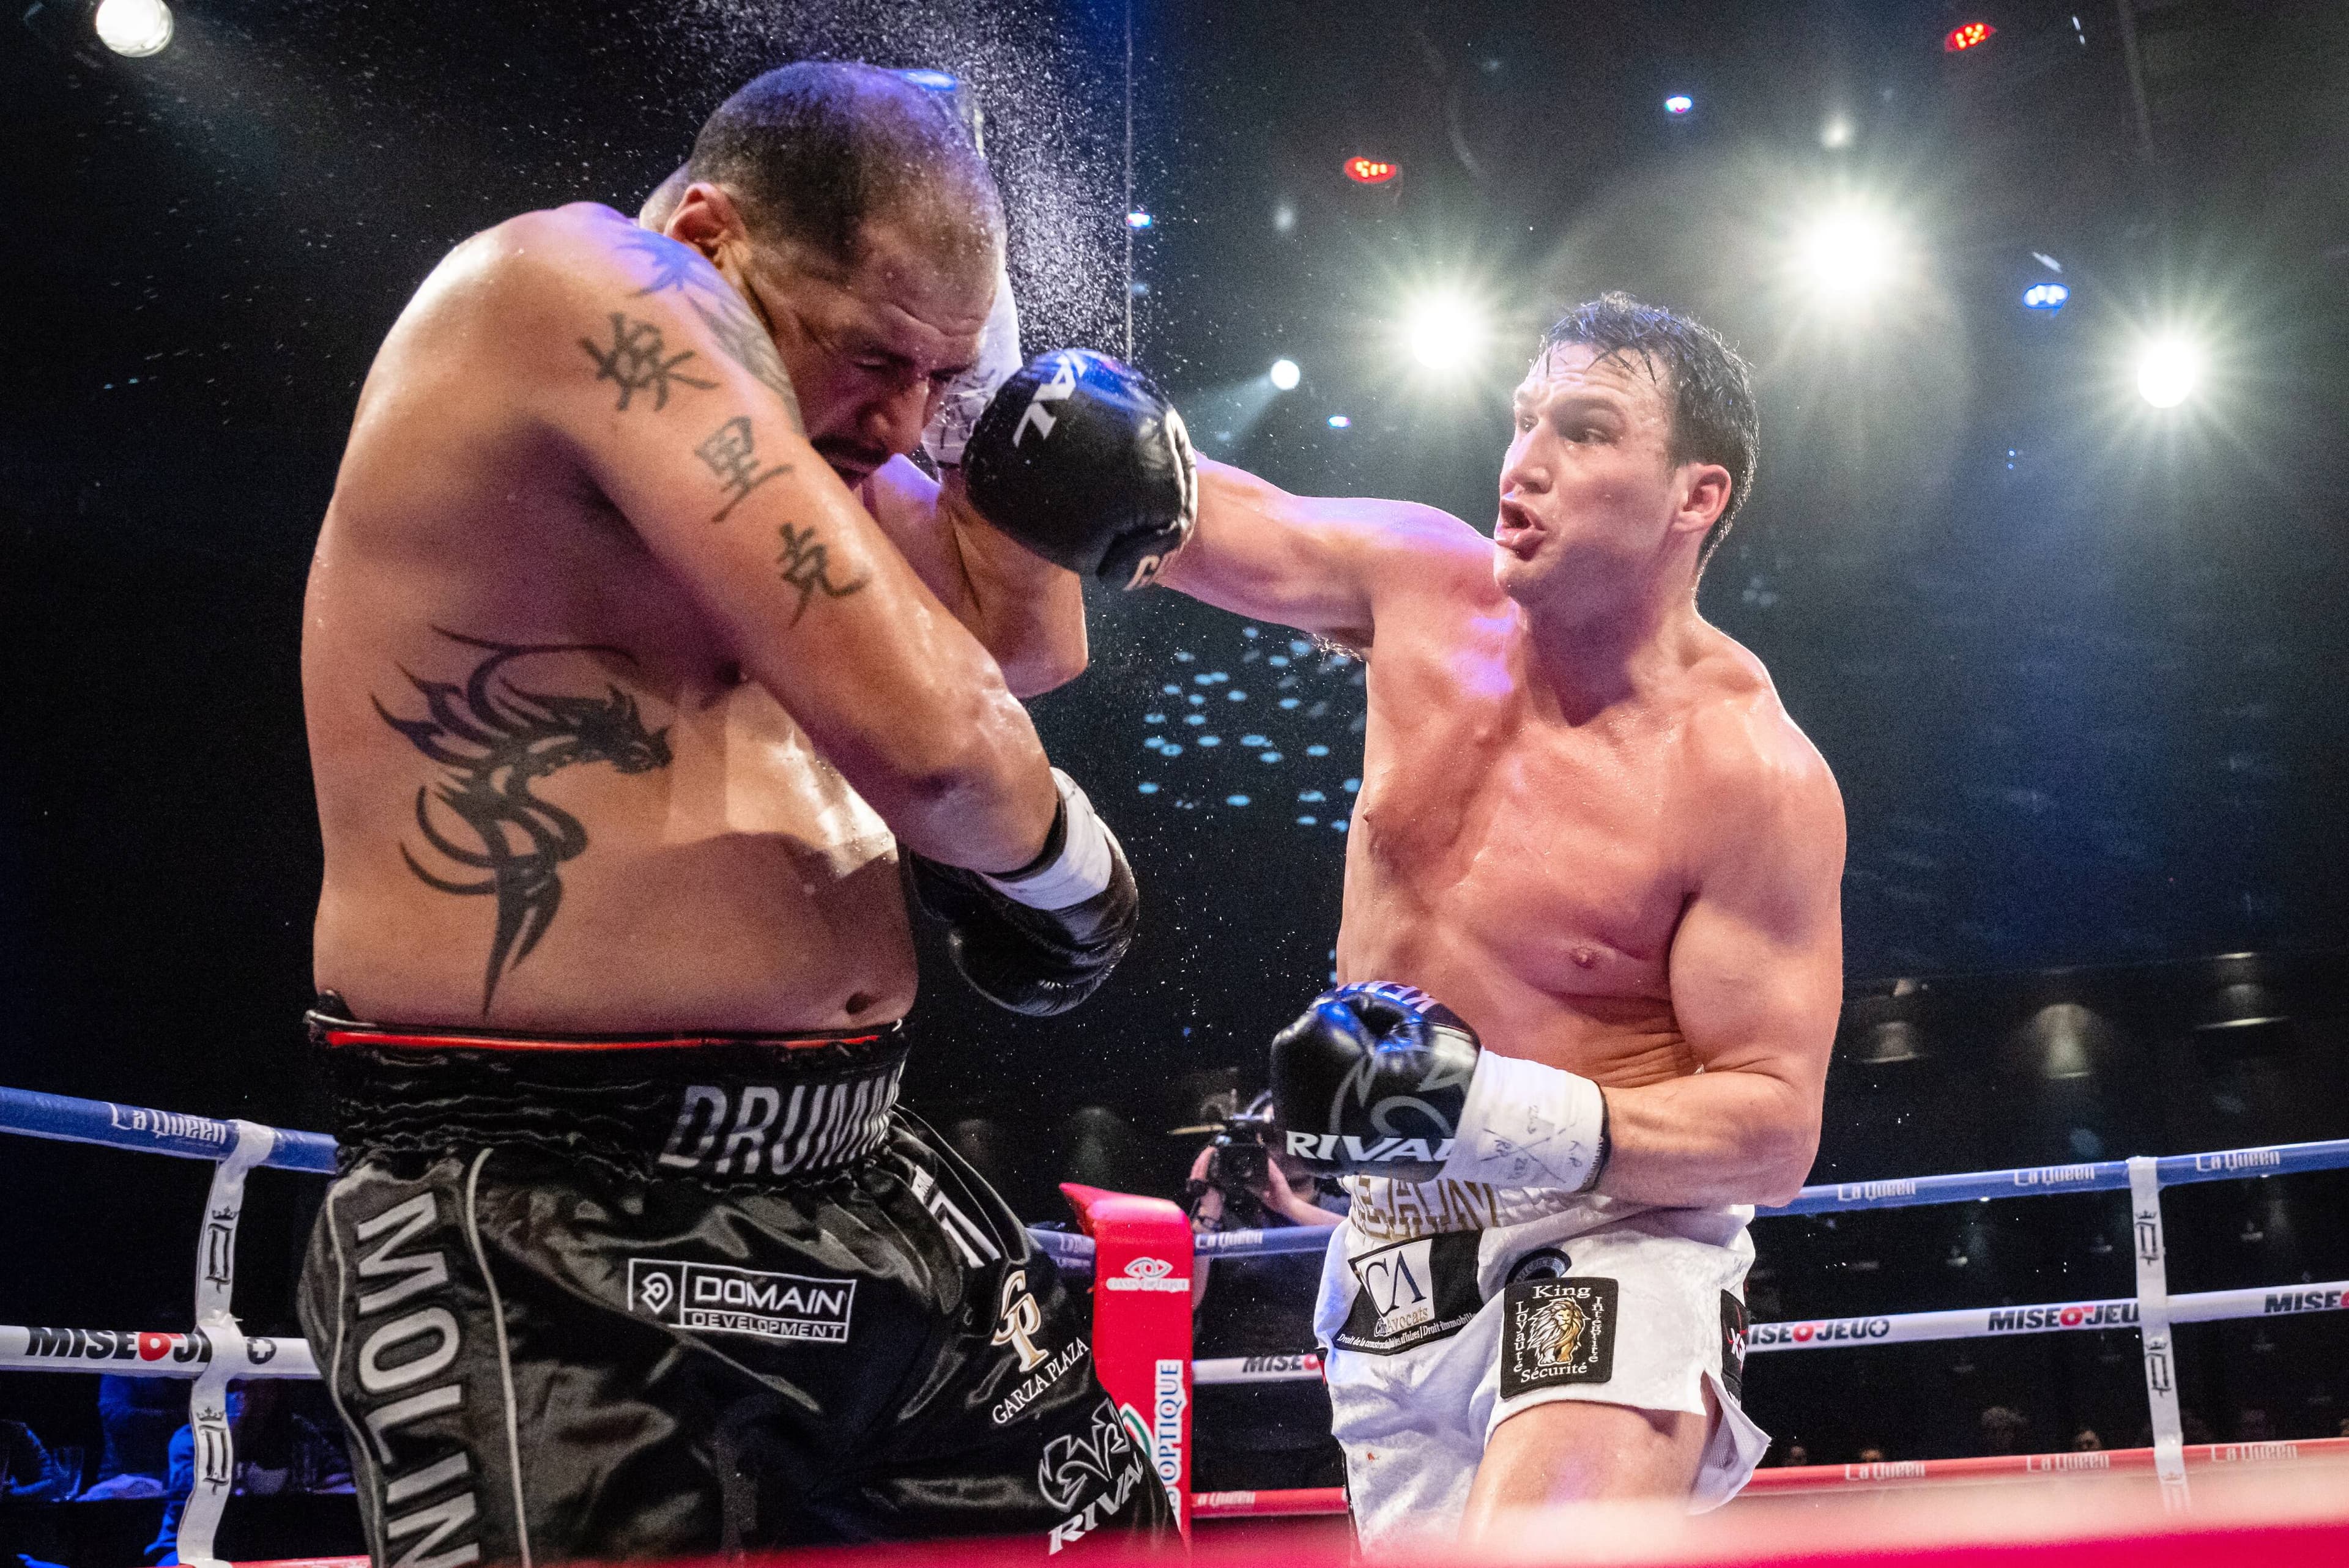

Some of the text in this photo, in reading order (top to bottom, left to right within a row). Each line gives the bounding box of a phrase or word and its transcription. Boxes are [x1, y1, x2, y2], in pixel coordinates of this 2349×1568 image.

[101, 1101, 226, 1145] La Queen
[2196, 1151, 2280, 1172] La Queen
[2014, 1166, 2095, 1186] La Queen
[1838, 1181, 1916, 1202] La Queen
[695, 1276, 845, 1315] DOMAIN
[1532, 1285, 1590, 1298] King
[692, 1313, 842, 1337] DEVELOPMENT
[1386, 1307, 1428, 1334] Avocats
[1423, 1322, 1441, 1336] Droit
[1513, 1301, 1529, 1372] Loyauté
[992, 1337, 1089, 1424] GARZA PLAZA
[1521, 1362, 1587, 1383] Sécurité
[1158, 1364, 1182, 1481] OPTIQUE
[2026, 1452, 2110, 1473] La Queen
[2211, 1444, 2298, 1463] La Queen
[1844, 1461, 1926, 1481] La Queen
